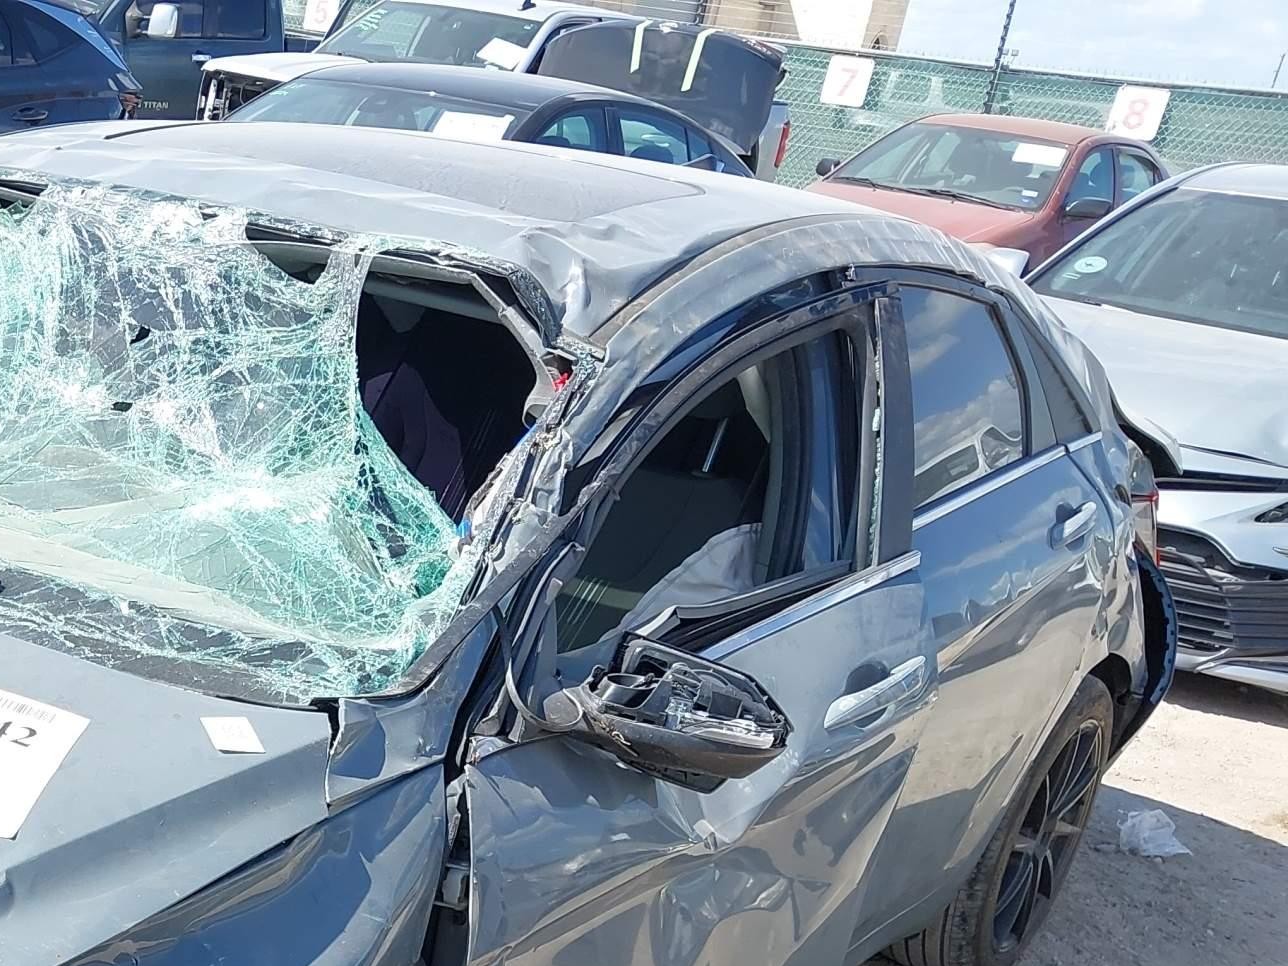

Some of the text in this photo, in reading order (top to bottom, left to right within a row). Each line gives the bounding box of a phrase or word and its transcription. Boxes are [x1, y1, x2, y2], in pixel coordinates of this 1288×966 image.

[314, 0, 329, 24] 5
[837, 67, 859, 96] 7
[143, 101, 169, 109] TITAN
[1122, 98, 1150, 129] 8
